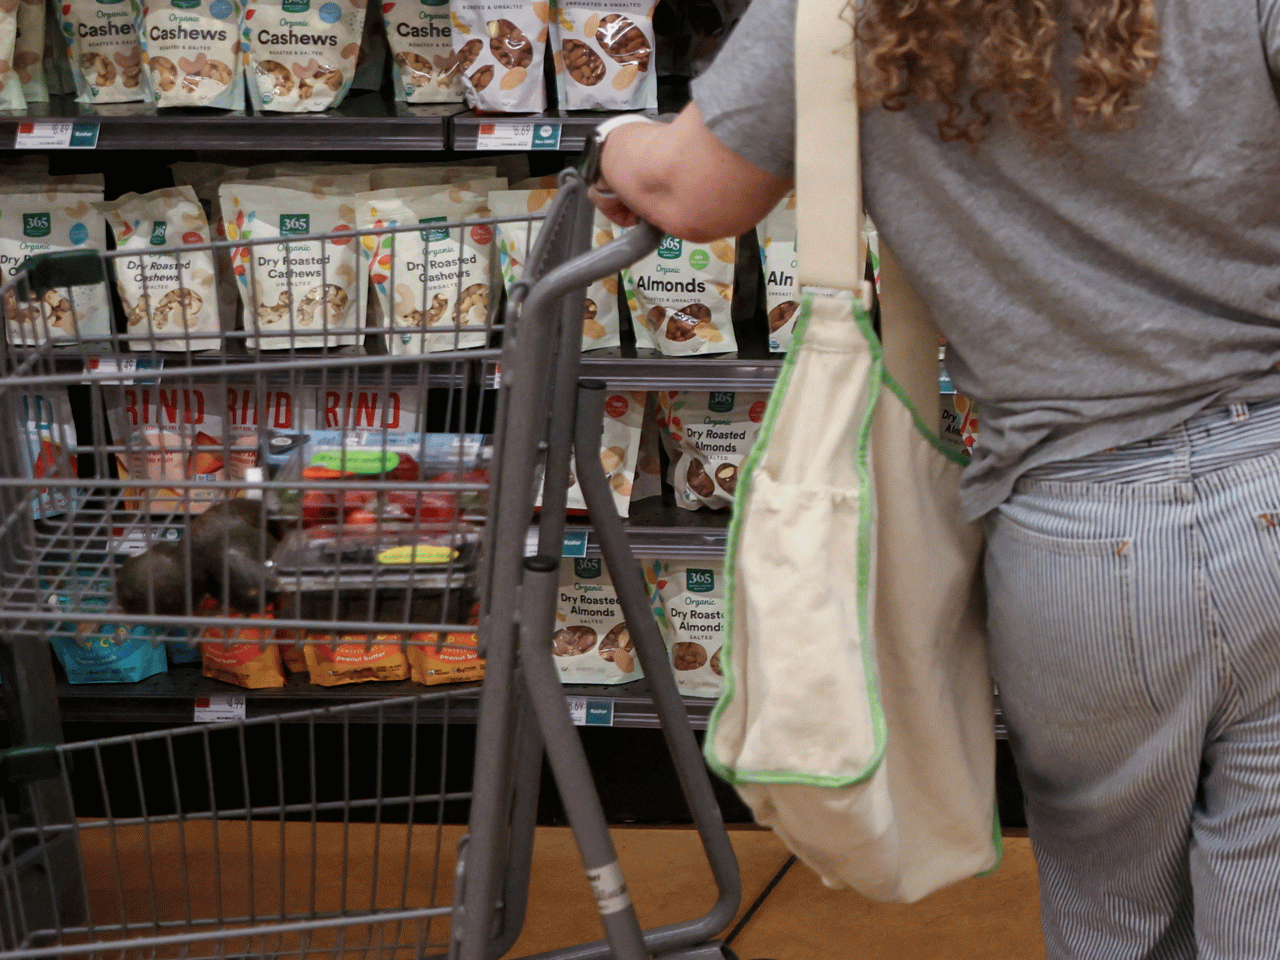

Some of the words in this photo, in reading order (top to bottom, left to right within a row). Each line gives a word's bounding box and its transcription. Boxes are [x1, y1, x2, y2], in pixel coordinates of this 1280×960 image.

[258, 30, 337, 46] Cashews
[656, 264, 680, 275] Organic
[637, 276, 705, 292] Almonds
[687, 428, 703, 440] Dry
[706, 430, 746, 439] Roasted
